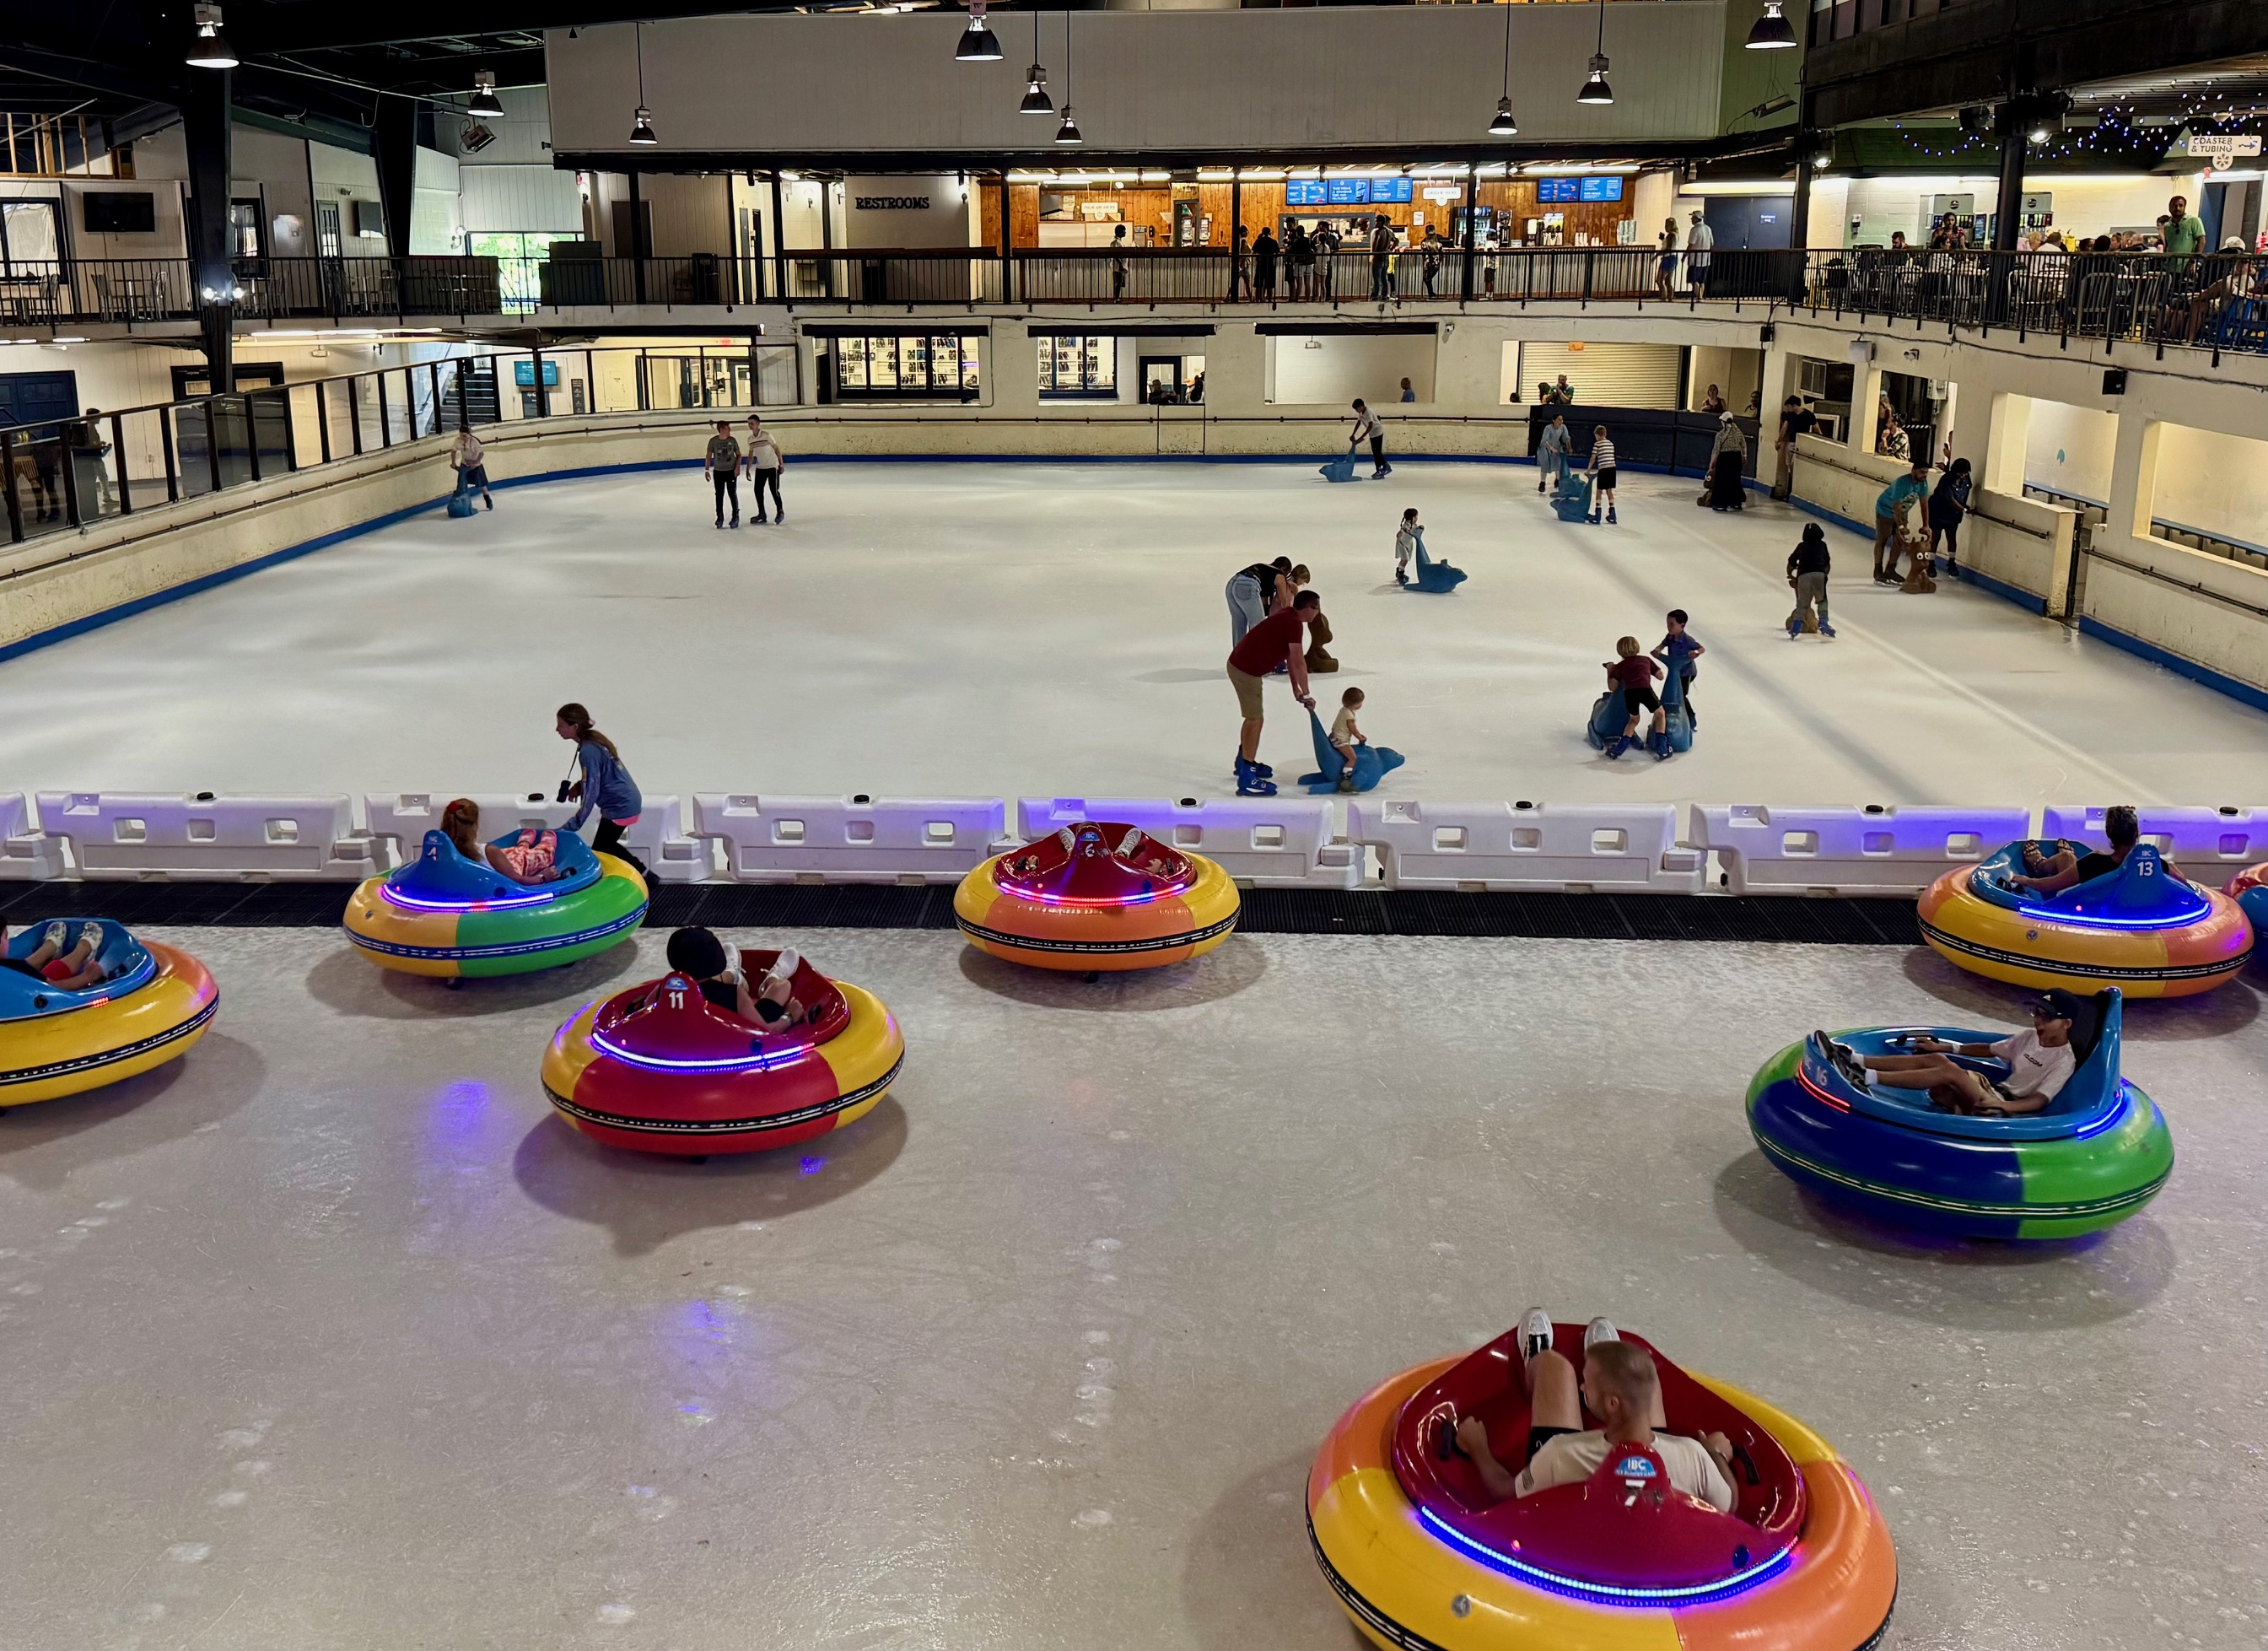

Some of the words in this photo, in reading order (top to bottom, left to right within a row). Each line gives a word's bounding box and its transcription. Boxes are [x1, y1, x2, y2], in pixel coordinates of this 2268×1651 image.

[855, 197, 930, 209] RESTROOMS
[2137, 861, 2153, 877] 13
[668, 991, 684, 1010] 11
[1817, 1066, 1828, 1086] 16
[1627, 1458, 1646, 1470] IBC
[1624, 1479, 1646, 1507] 7
